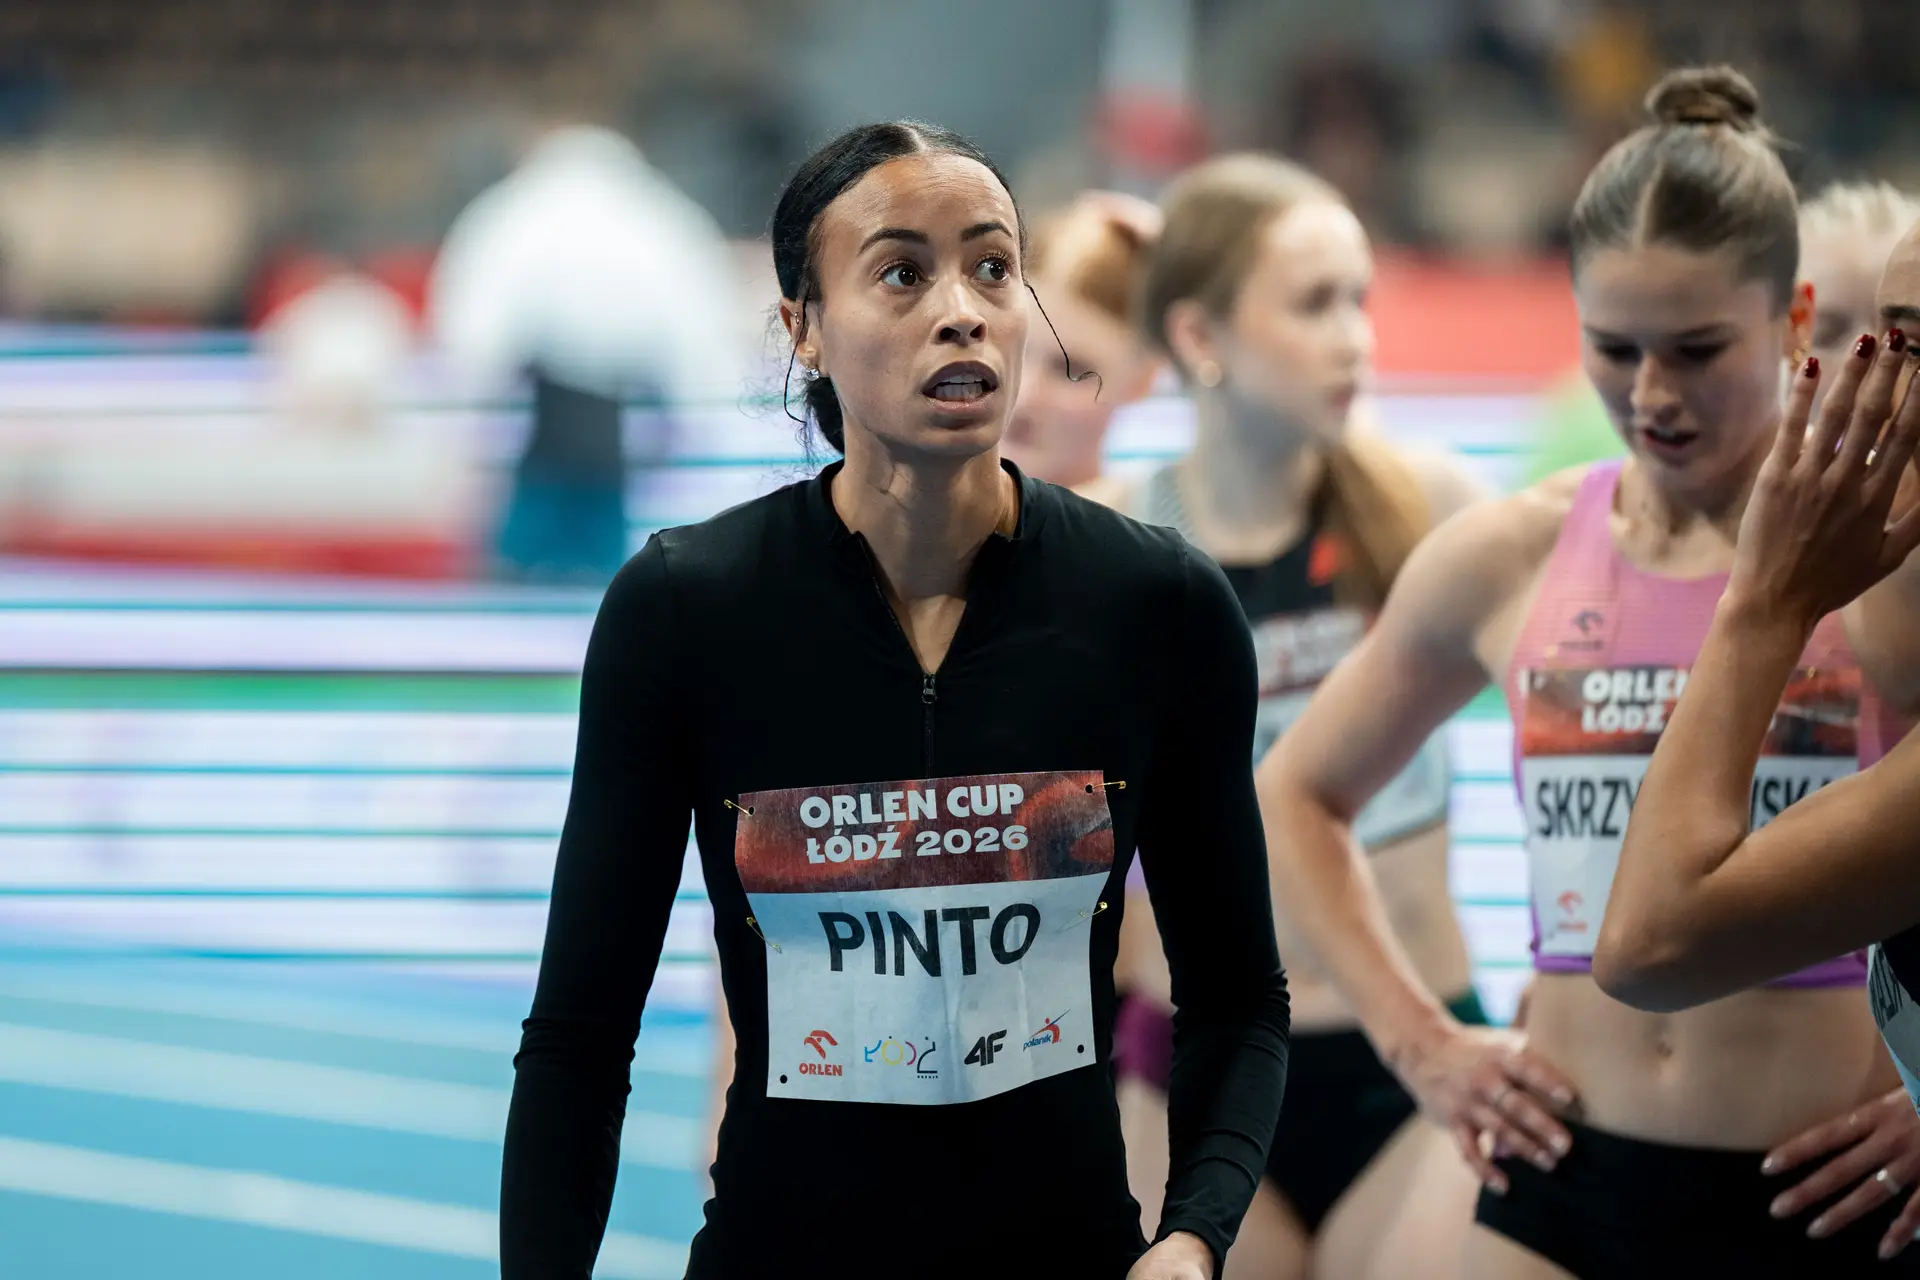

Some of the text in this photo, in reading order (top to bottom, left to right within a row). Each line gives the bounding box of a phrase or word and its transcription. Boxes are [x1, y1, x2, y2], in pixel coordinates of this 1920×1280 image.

[800, 783, 1024, 829] ORLEN CUP
[806, 824, 1029, 864] ŁÓDŹ 2026
[817, 903, 1041, 977] PINTO
[963, 1029, 1008, 1067] 4F
[1023, 1033, 1052, 1052] polanik
[799, 1062, 843, 1077] ORLEN
